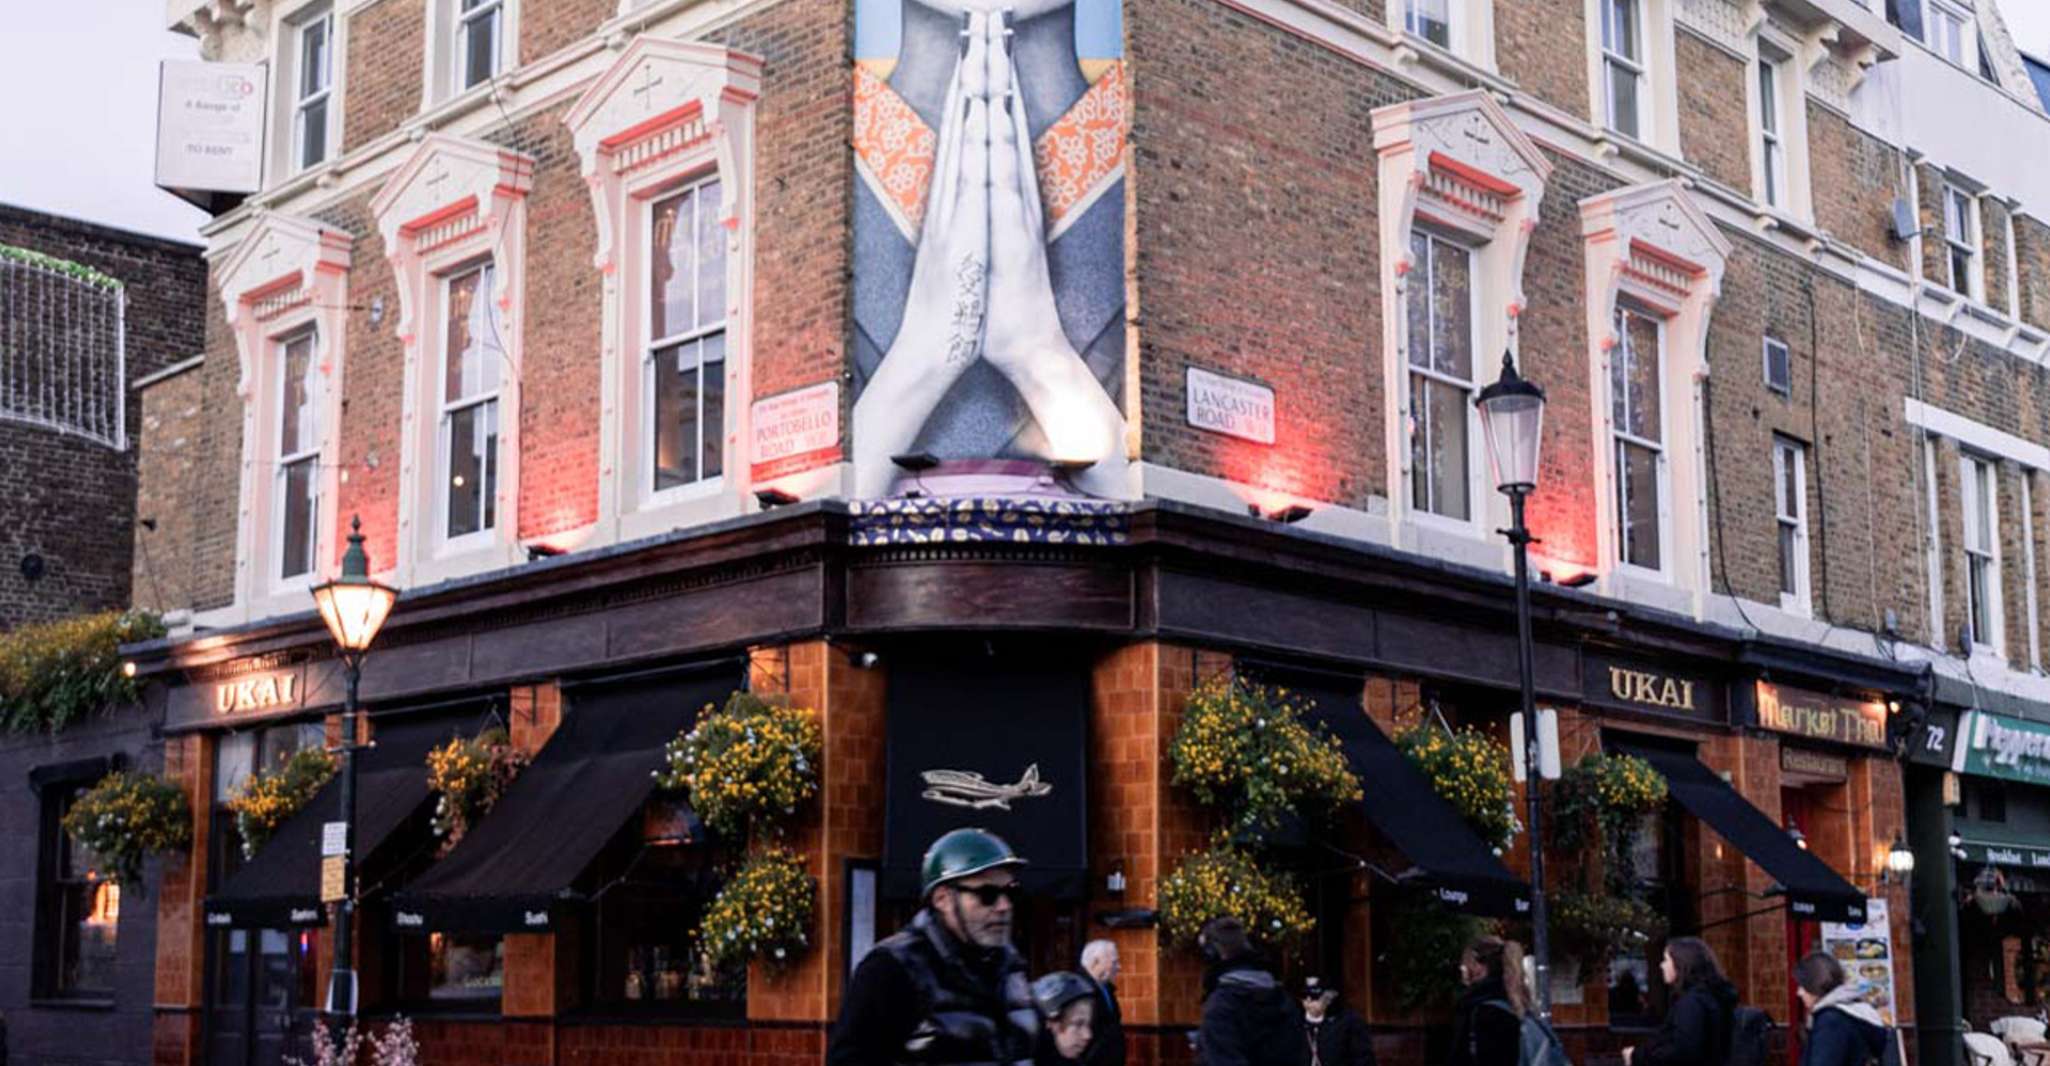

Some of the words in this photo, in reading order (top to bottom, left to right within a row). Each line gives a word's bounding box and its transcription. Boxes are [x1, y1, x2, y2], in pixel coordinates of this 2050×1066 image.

[1193, 387, 1269, 420] LANCASTER
[1197, 405, 1236, 429] ROAD
[217, 673, 295, 714] UKAI
[1608, 665, 1696, 710] UKAI
[1925, 724, 1946, 753] 72
